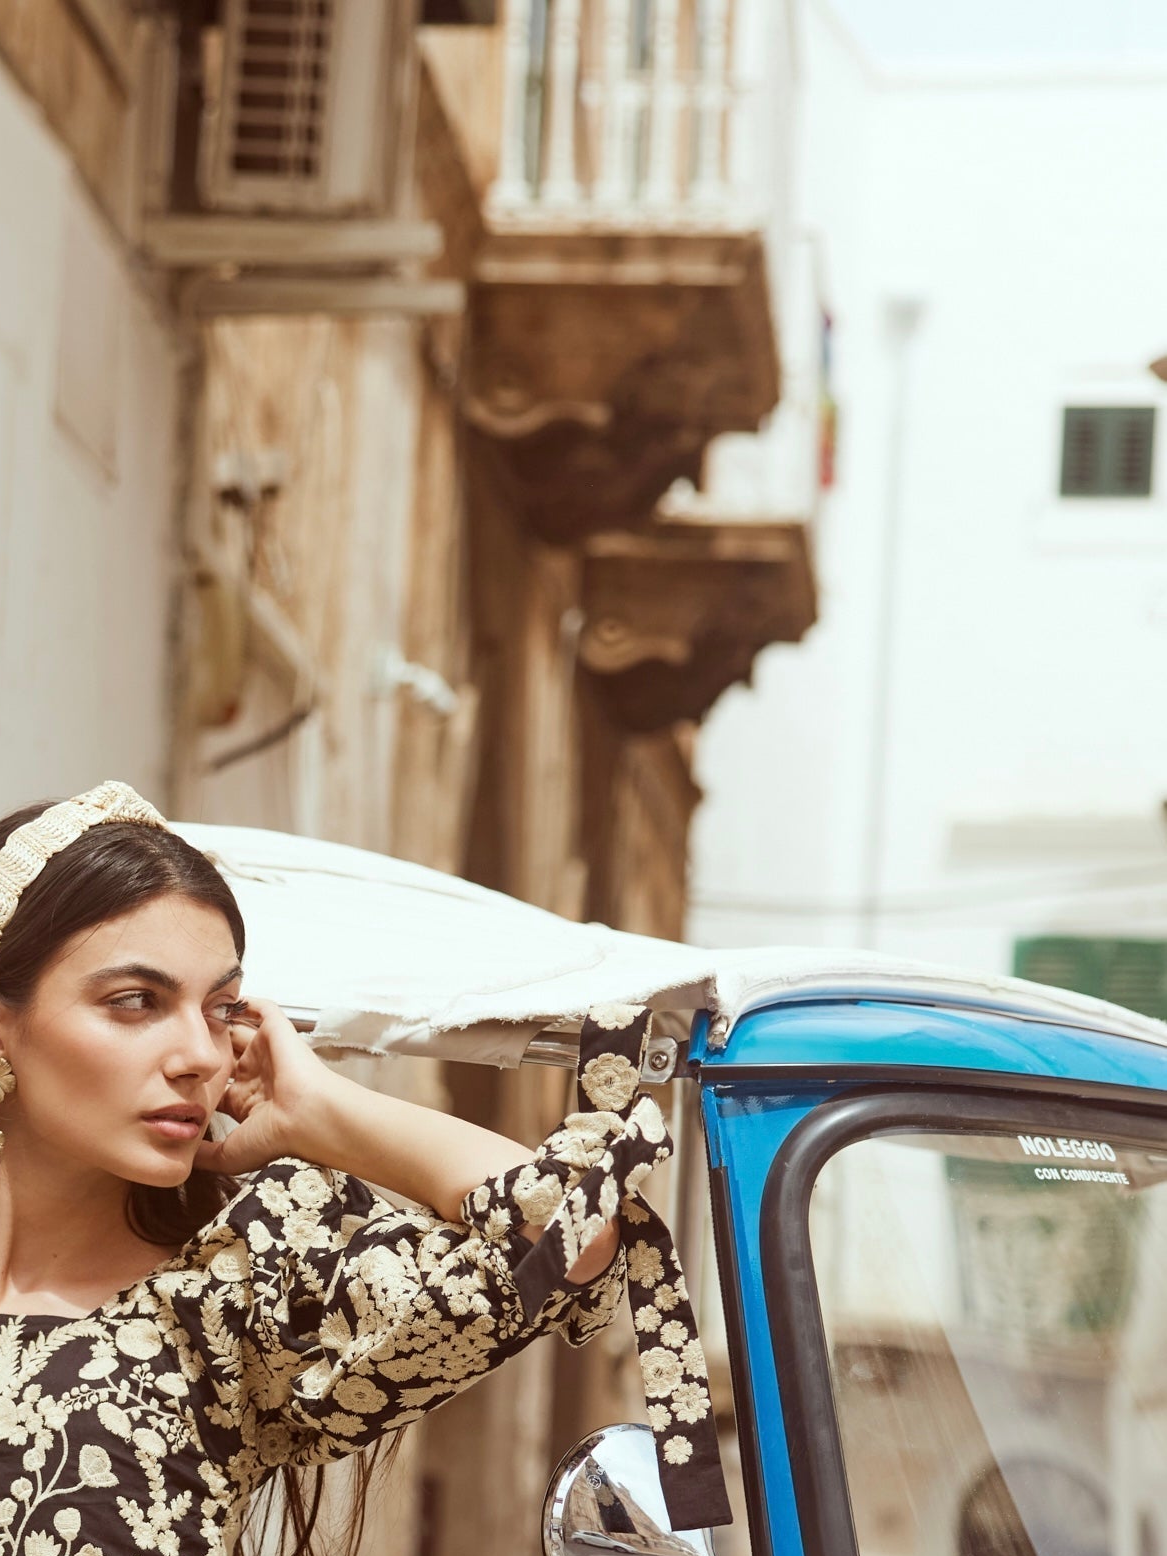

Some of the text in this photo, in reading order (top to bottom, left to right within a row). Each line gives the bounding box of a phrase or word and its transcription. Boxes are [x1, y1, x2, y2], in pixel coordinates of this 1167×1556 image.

[1017, 1135, 1117, 1162] NOLEGGIO
[1034, 1168, 1130, 1185] CON CONDUCENTE
